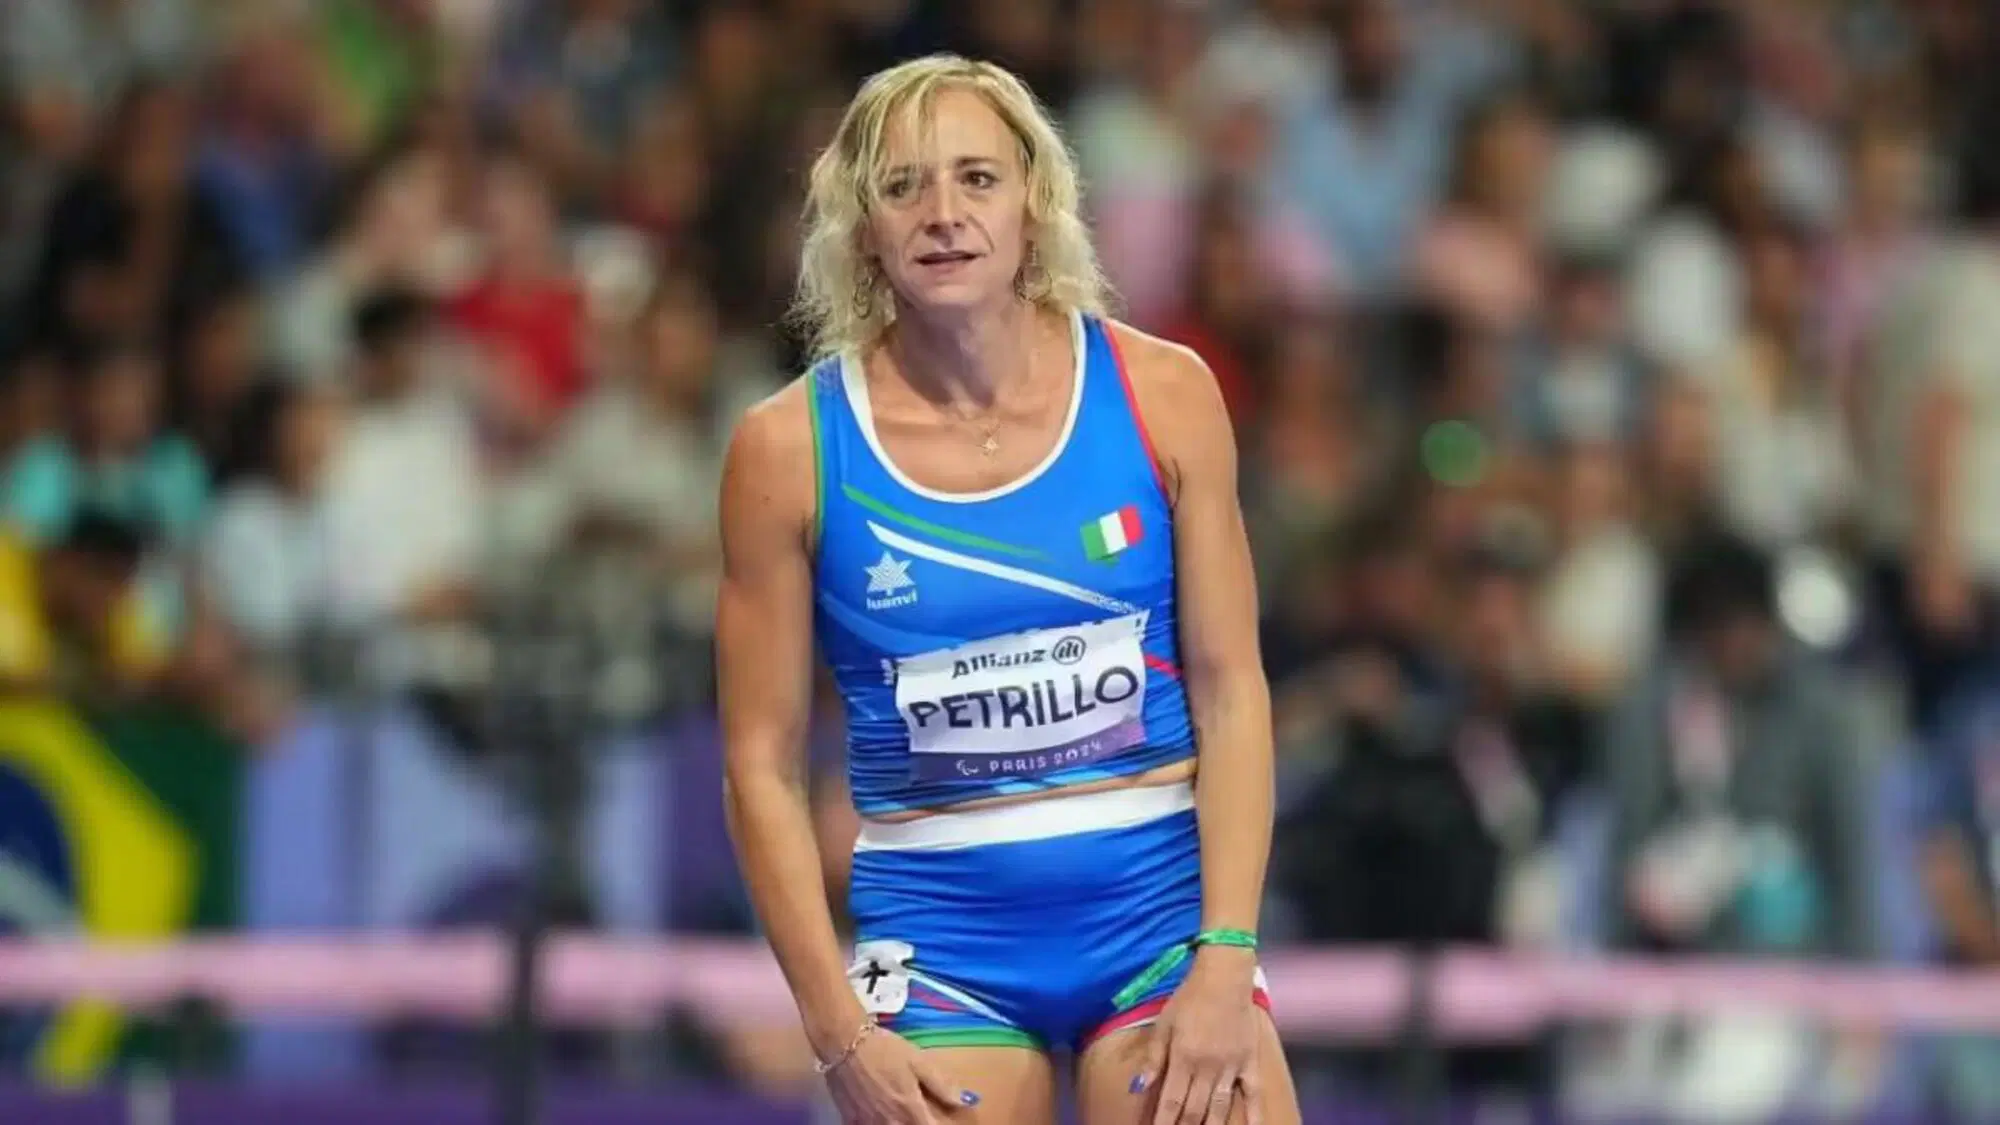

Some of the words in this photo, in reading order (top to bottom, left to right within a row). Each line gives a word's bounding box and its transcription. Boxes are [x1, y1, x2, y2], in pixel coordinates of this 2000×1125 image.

[952, 648, 1047, 679] Allianz
[908, 665, 1139, 729] PETRILLO
[989, 756, 1049, 773] PARIS
[1053, 739, 1103, 766] 2024
